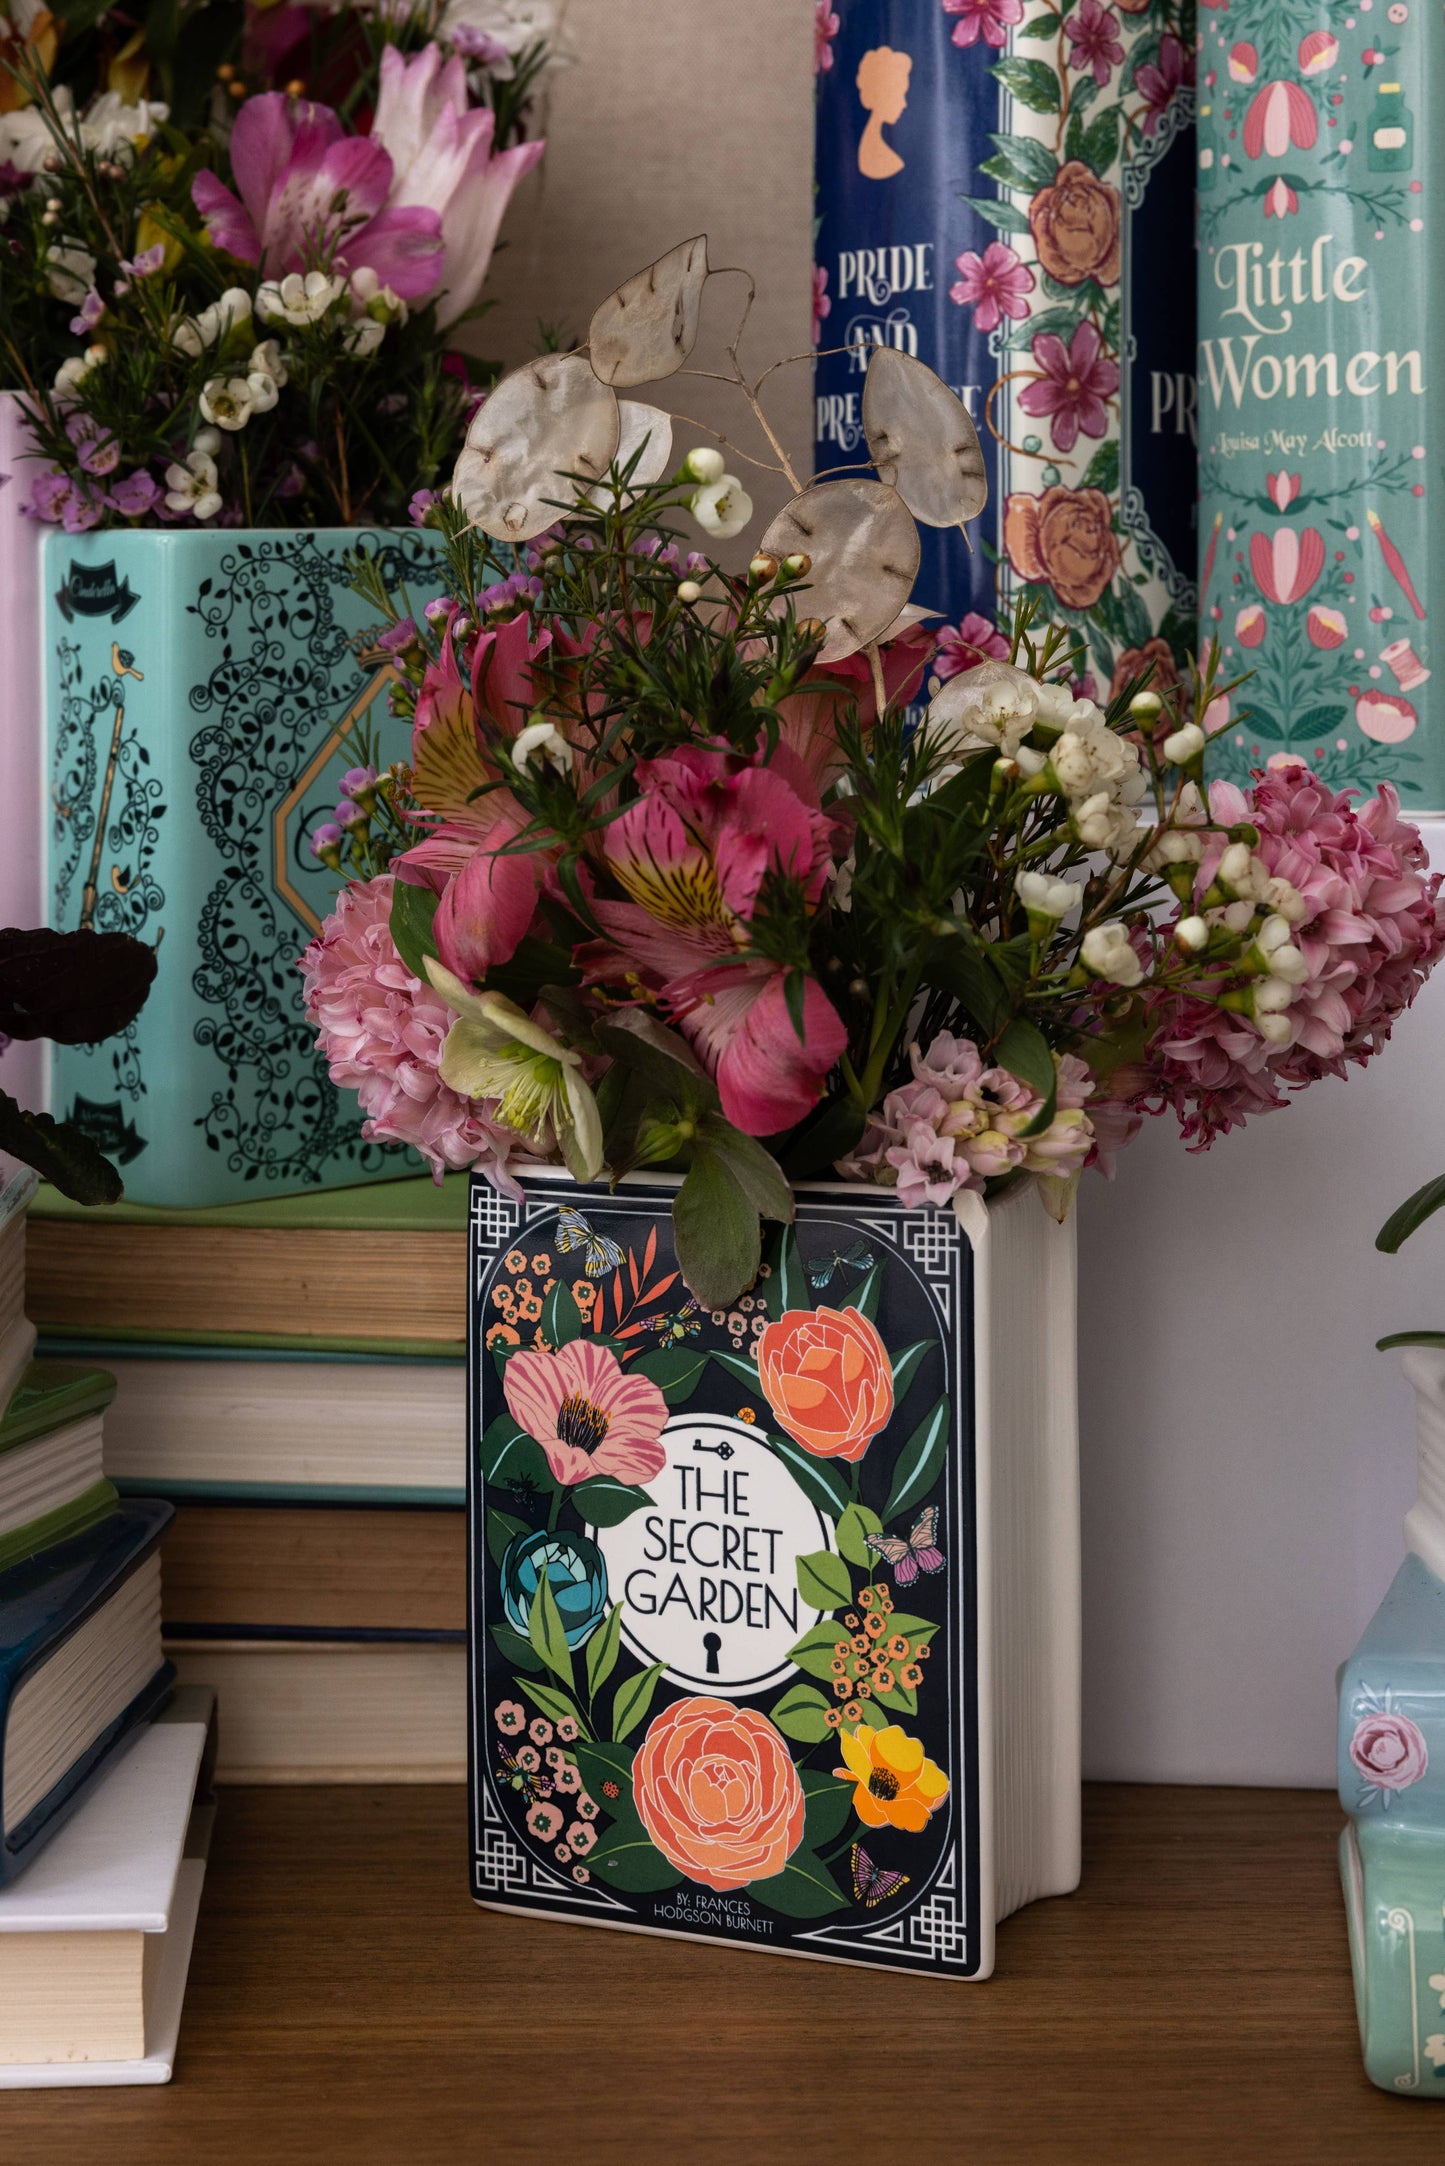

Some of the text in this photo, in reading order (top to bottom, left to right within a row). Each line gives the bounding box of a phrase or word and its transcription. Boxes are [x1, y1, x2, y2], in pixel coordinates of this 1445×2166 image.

[838, 243, 934, 307] PRIDE
[1214, 234, 1368, 335] Little
[1199, 334, 1428, 411] Women
[1218, 427, 1373, 459] Louisa May Alcott
[673, 1465, 750, 1516] THE
[643, 1515, 783, 1574] SECRET
[624, 1569, 798, 1634] GARDEN
[654, 1904, 774, 1935] HODGSON BURNETT
[676, 1892, 751, 1916] BY: FRANCES
